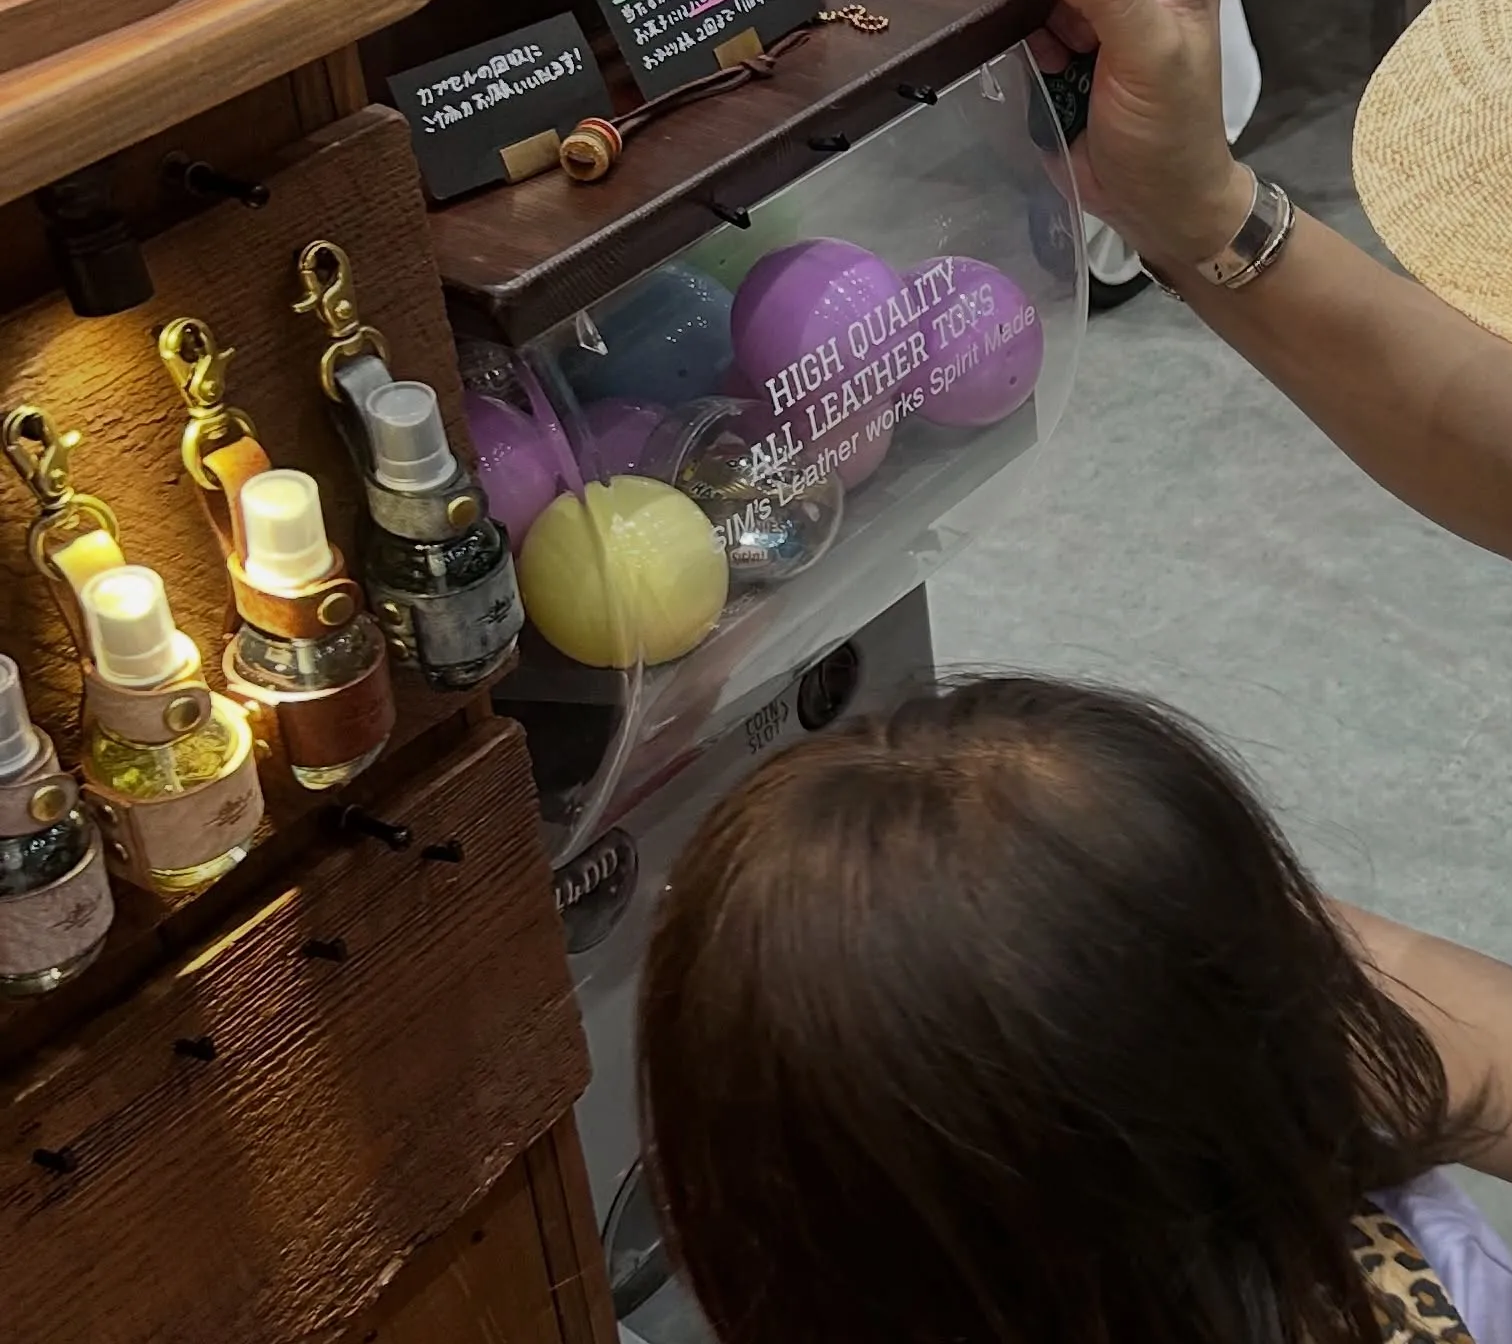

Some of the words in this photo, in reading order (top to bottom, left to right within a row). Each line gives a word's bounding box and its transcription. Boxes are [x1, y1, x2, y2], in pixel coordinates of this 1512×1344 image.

[749, 421, 803, 487] ALL
[805, 330, 930, 441] LEATHER
[932, 282, 996, 350] TOYS
[764, 336, 845, 417] HIGH
[847, 256, 956, 360] QUALITY
[710, 497, 772, 554] SIM's
[777, 431, 860, 507] Leather
[865, 386, 925, 442] works
[929, 344, 980, 396] Spirit
[983, 305, 1036, 357] Made
[745, 698, 780, 736] COIN
[748, 716, 780, 755] SLOT
